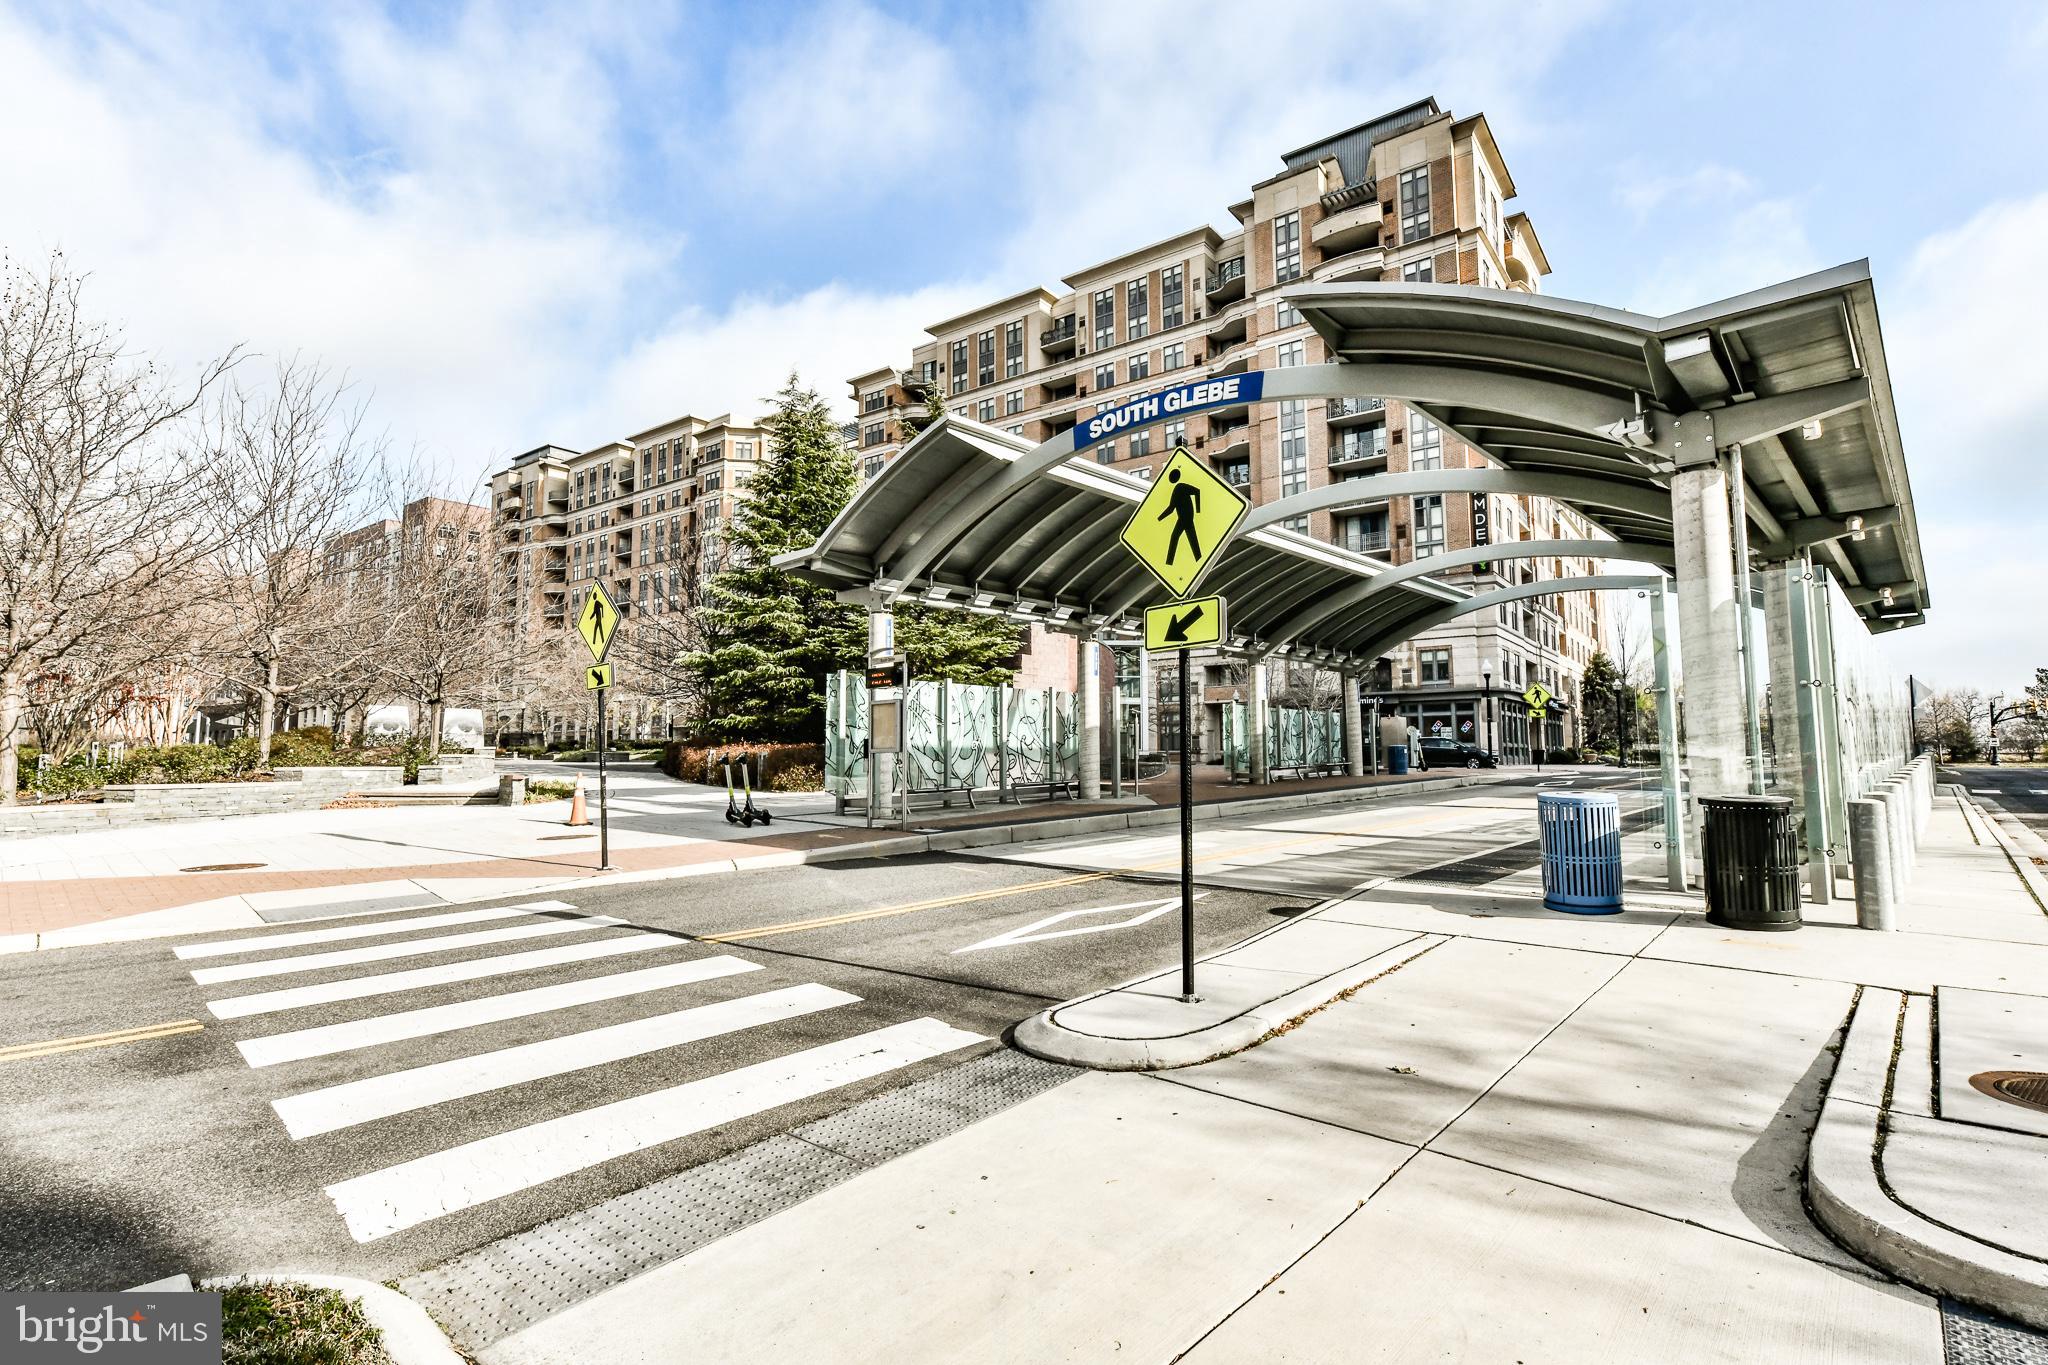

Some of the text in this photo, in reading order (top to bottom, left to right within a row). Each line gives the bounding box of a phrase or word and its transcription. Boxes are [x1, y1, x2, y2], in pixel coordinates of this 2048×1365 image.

[1089, 378, 1240, 439] SOUTH GLEBE
[1473, 492, 1487, 547] MDE
